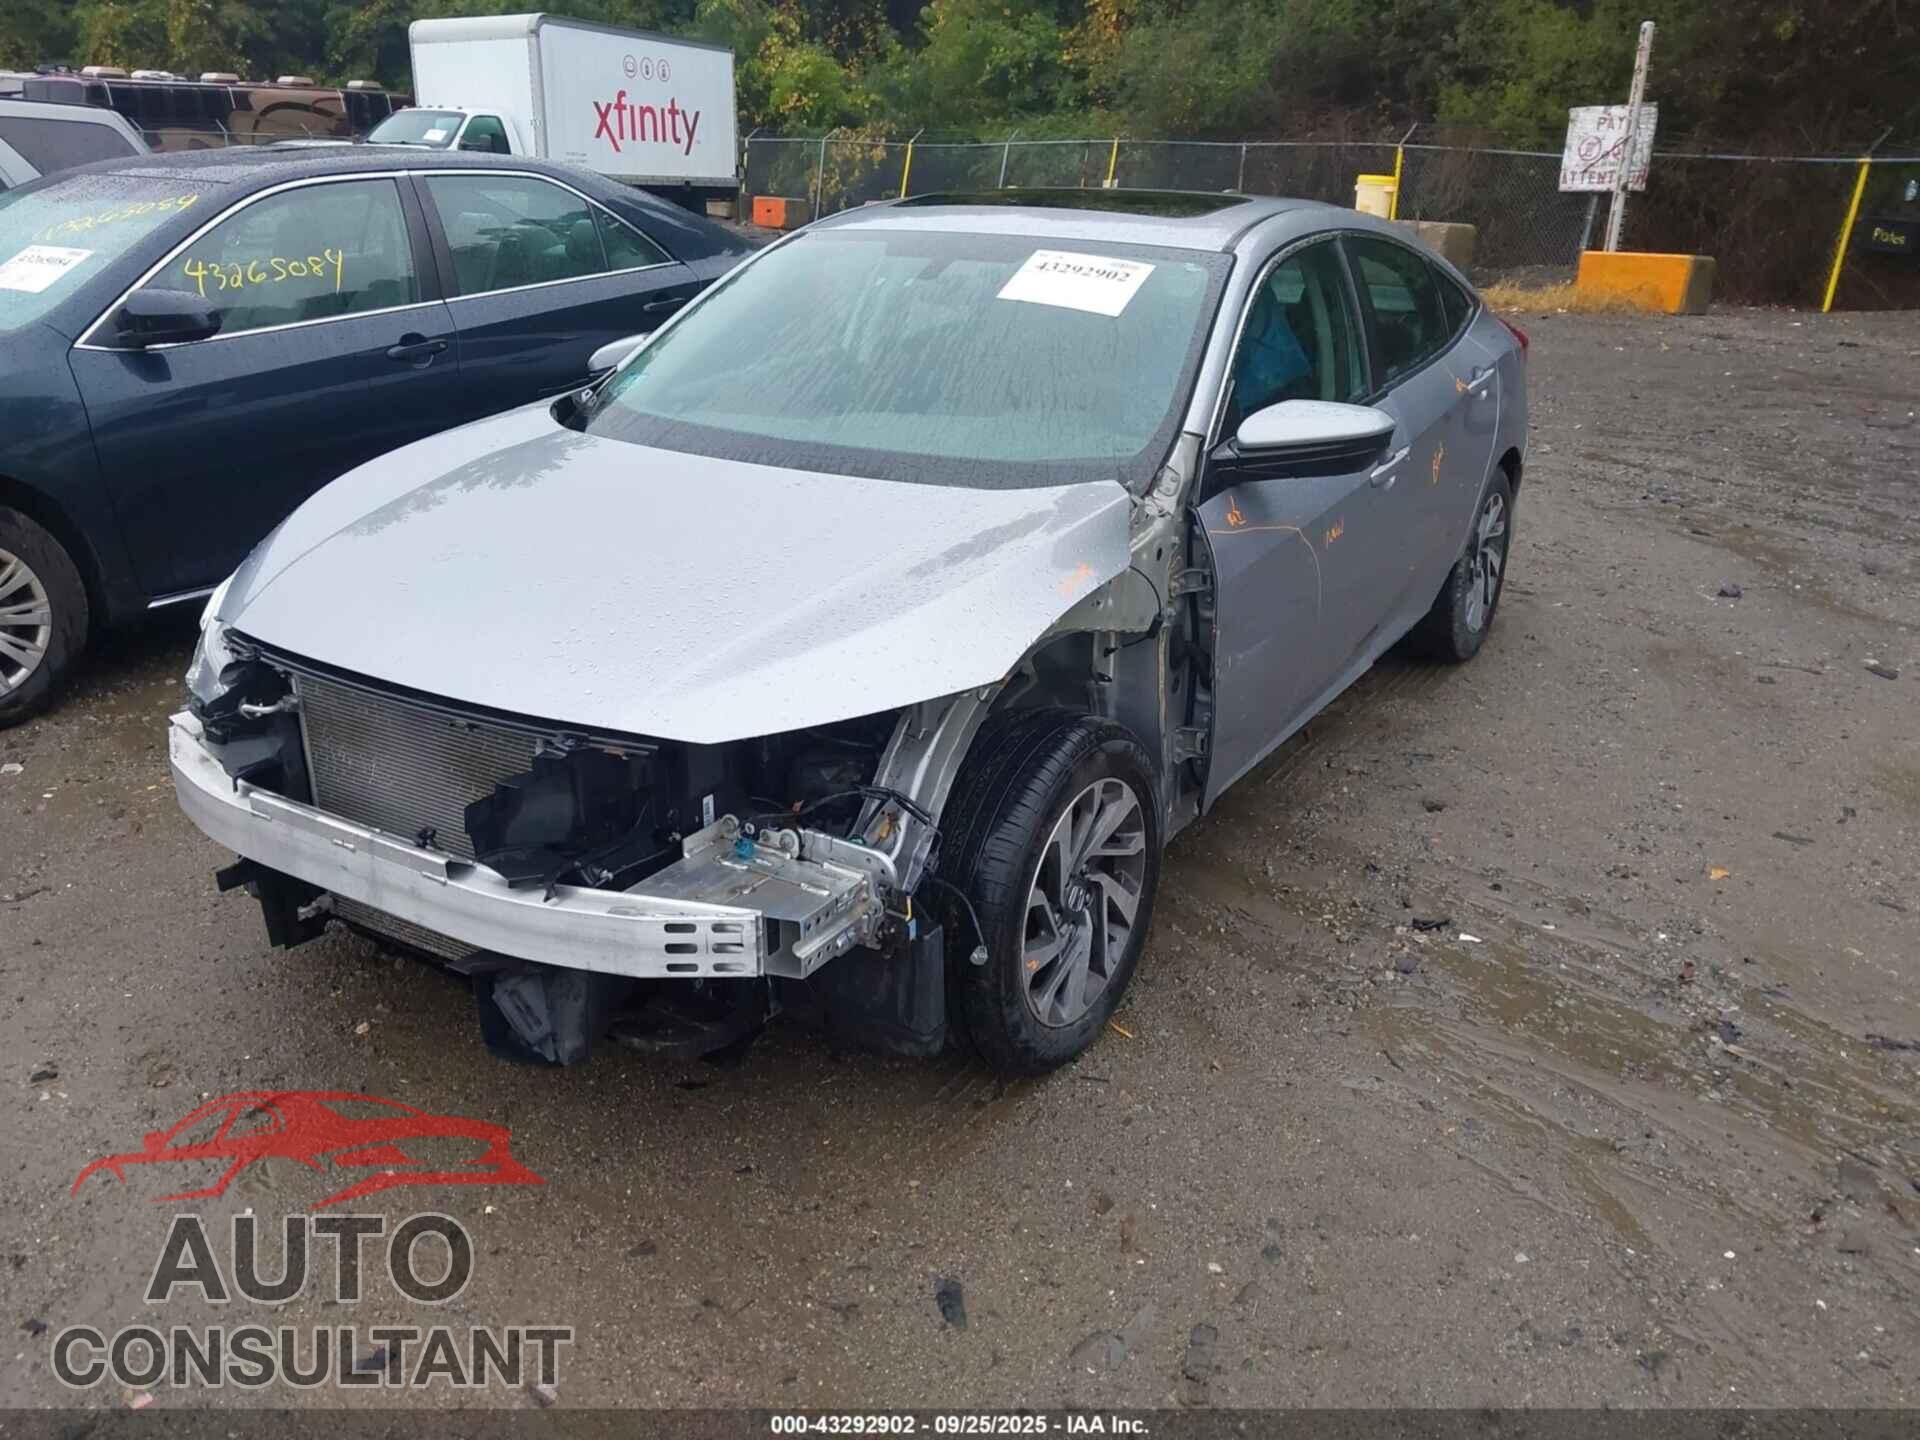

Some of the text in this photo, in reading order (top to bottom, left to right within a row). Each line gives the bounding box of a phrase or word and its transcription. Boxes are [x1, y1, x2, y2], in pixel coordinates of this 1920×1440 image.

[593, 90, 700, 156] xfinity
[184, 249, 343, 297] 43265084
[1035, 261, 1131, 283] 43292902
